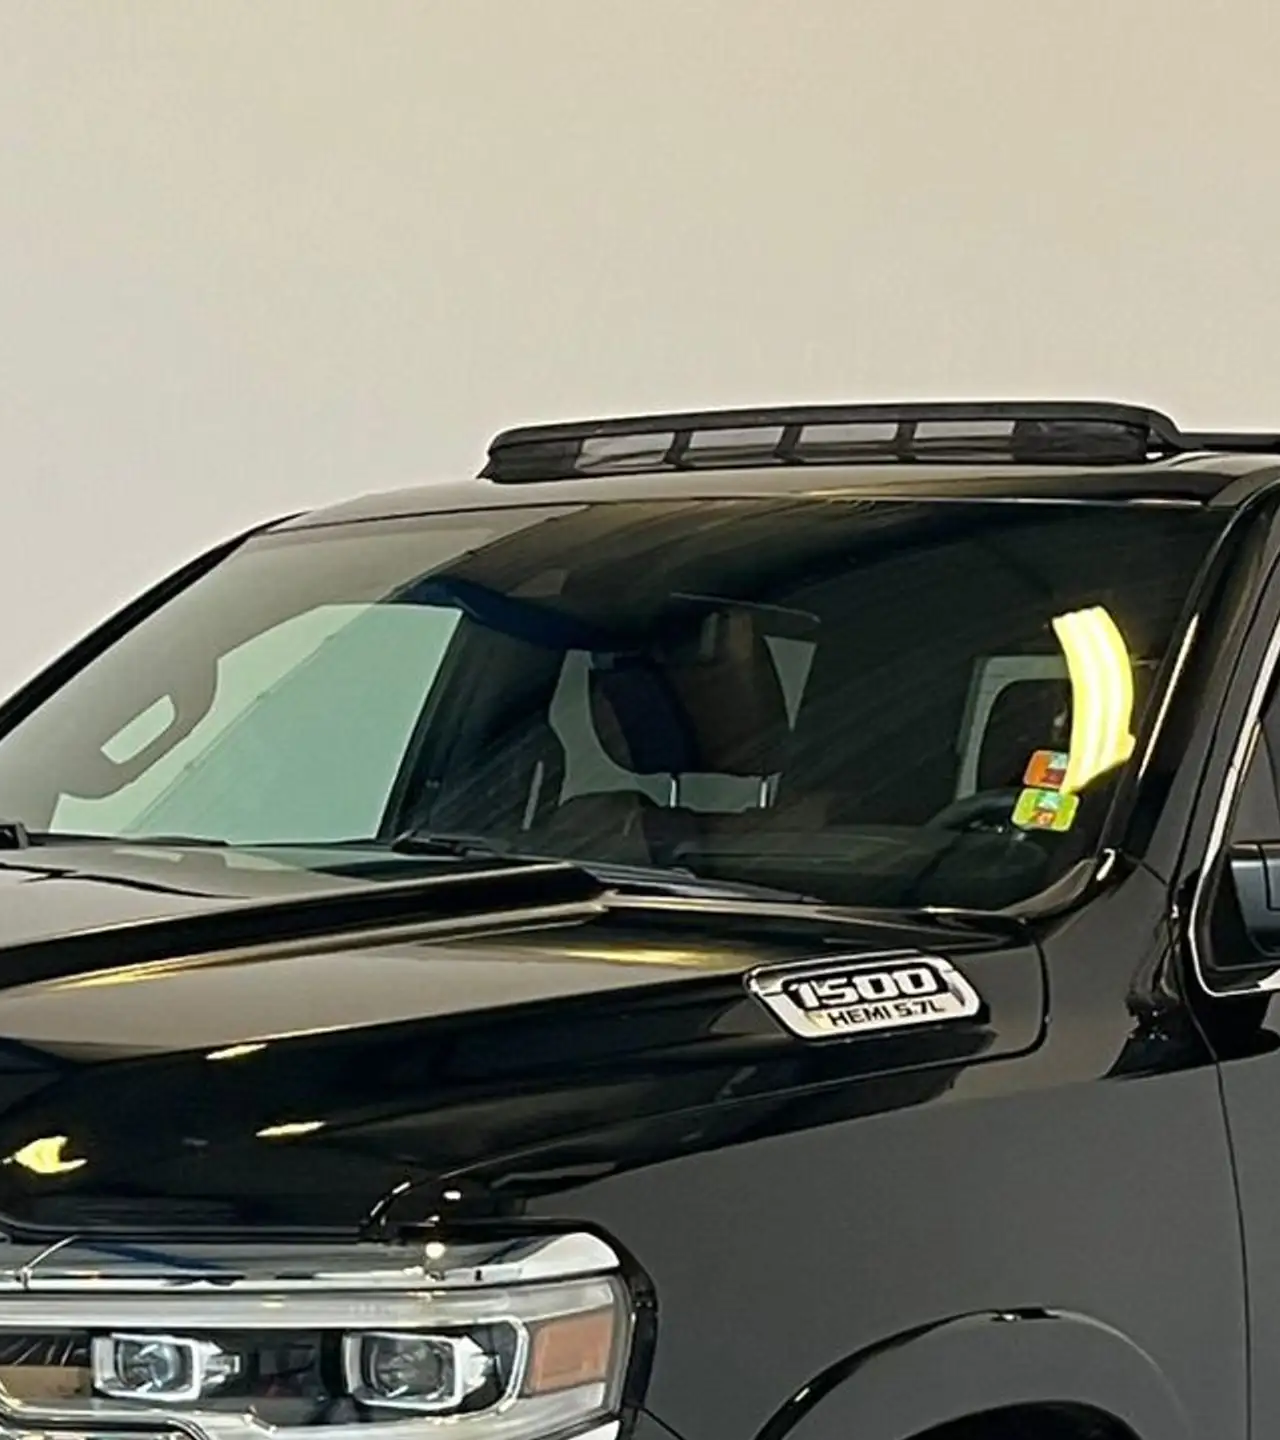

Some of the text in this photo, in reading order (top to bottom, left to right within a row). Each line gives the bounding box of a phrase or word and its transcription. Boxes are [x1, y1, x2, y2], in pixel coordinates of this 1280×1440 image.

[789, 967, 939, 1009] 1500
[826, 1000, 946, 1027] HEMI 5.7L
